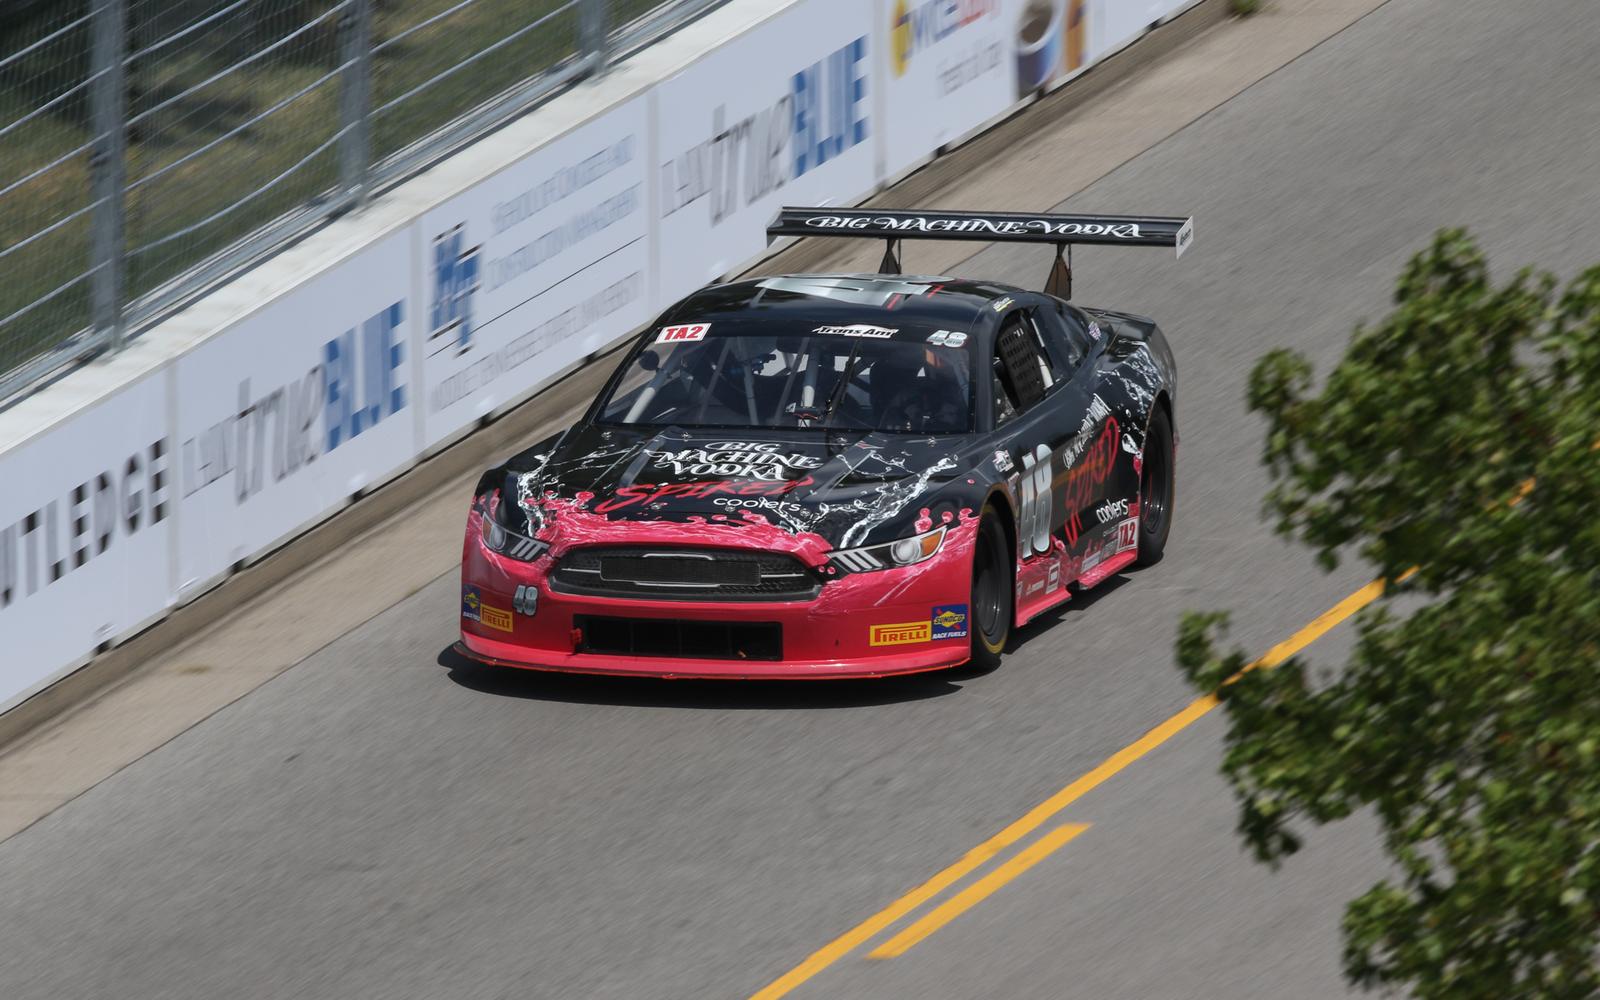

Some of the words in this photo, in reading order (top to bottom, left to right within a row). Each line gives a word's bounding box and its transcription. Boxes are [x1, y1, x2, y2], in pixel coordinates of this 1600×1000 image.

[806, 216, 870, 229] BIG
[873, 217, 1028, 235] MACHINE
[1026, 220, 1144, 238] VODKA
[665, 326, 703, 340] TA2
[705, 441, 781, 452] BIG
[643, 448, 824, 469] MACHINE
[654, 459, 789, 481] VODKA
[713, 496, 802, 513] coolers
[1096, 497, 1129, 524] coolers
[1119, 522, 1136, 547] TA2
[513, 585, 539, 616] 48
[874, 624, 928, 642] PIRELLI
